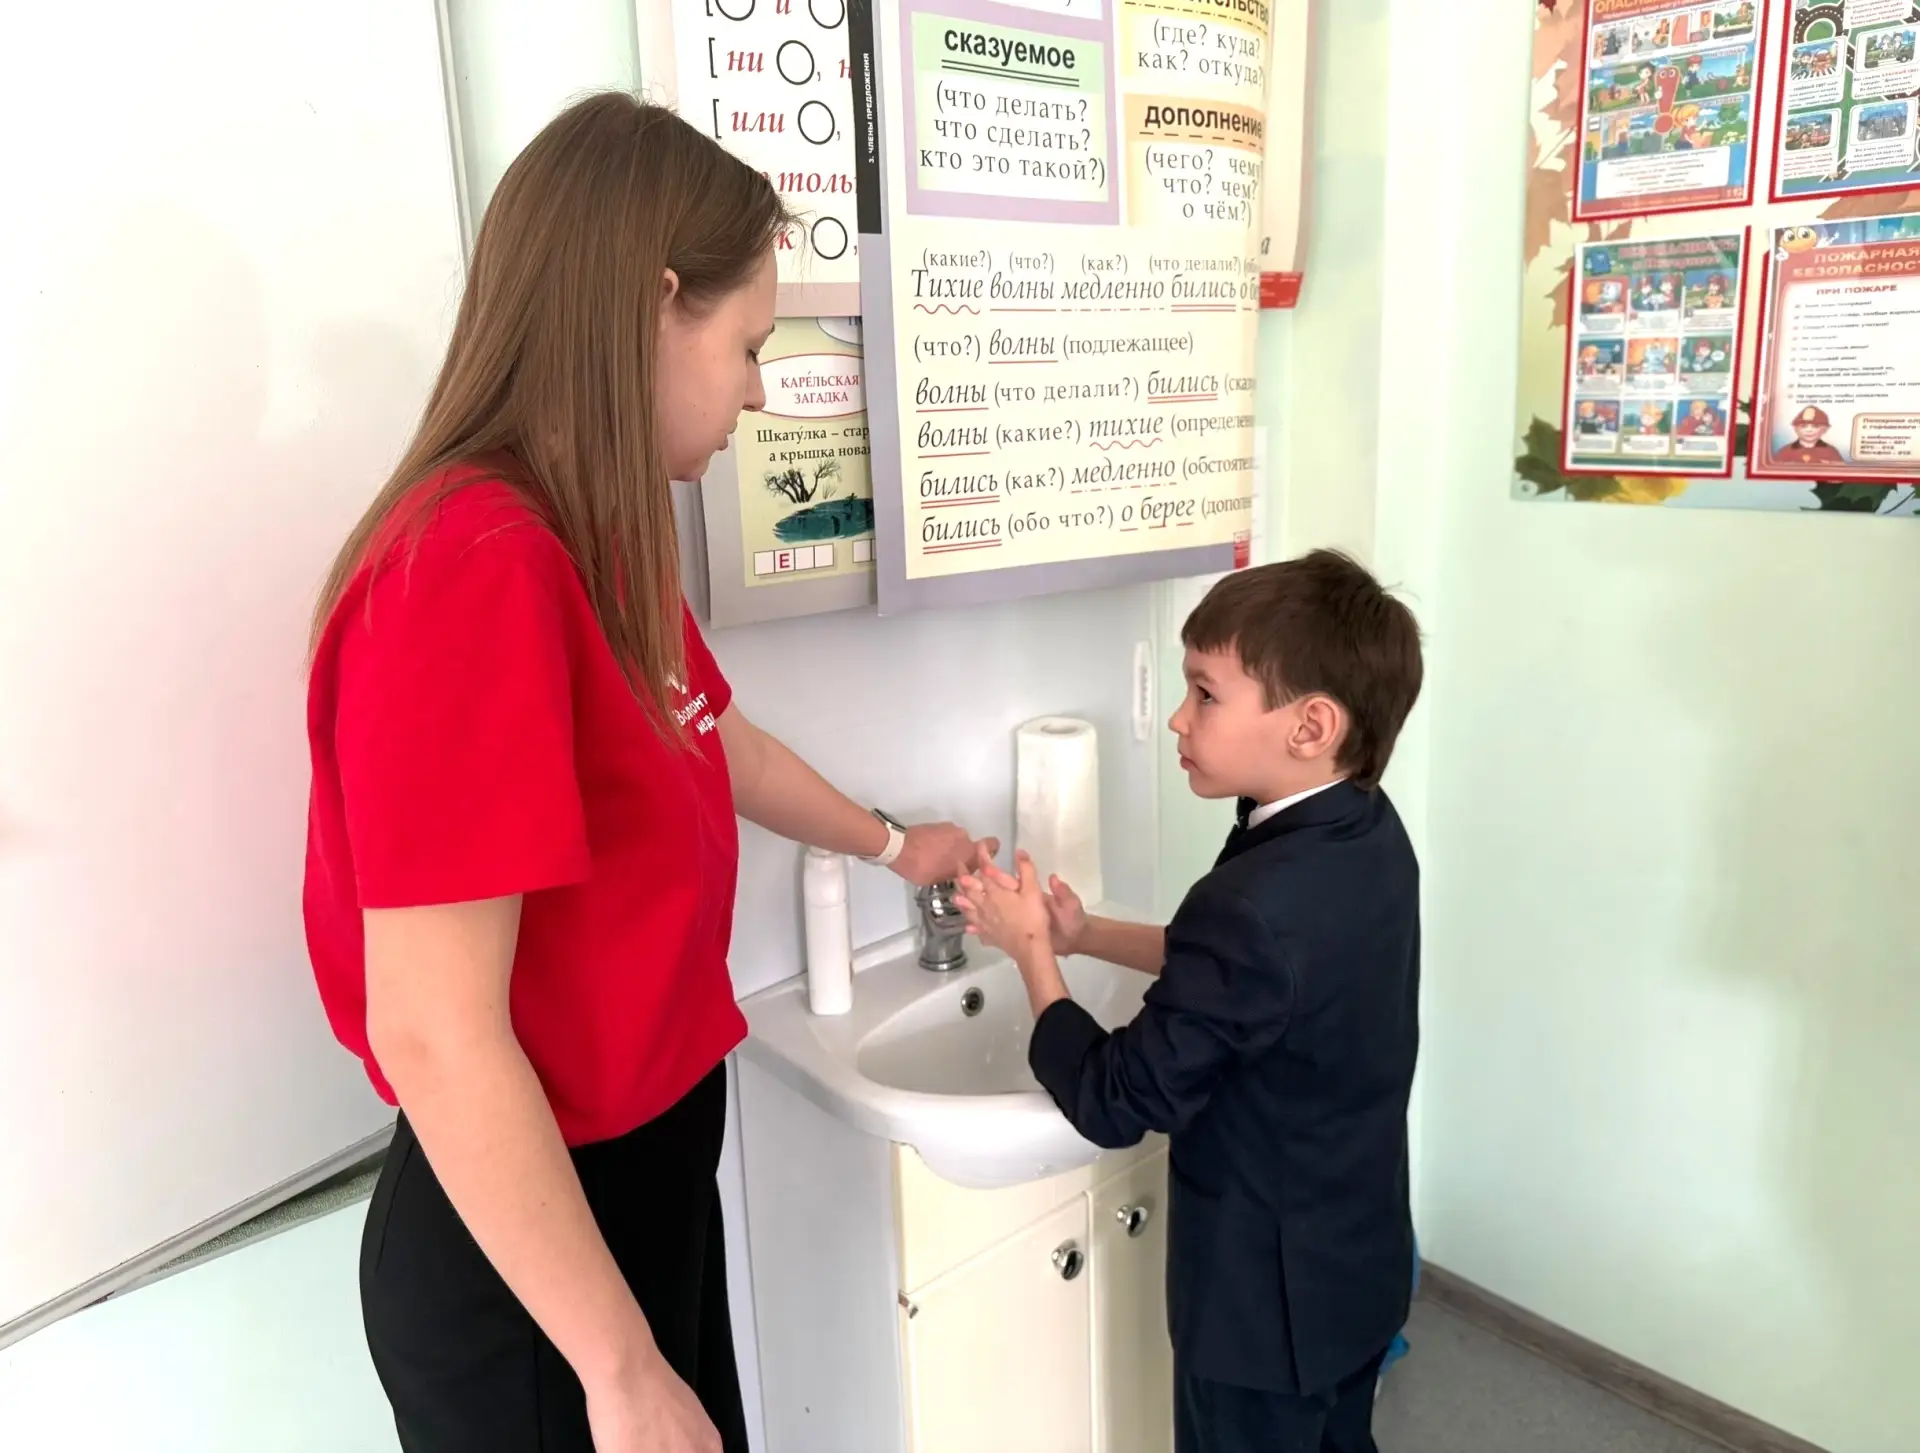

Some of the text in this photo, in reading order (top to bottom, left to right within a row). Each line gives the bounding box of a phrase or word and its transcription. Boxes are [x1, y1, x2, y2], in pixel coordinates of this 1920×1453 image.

[944, 29, 1076, 69] сказуемое
[1154, 18, 1261, 59] (где? куда?
[727, 50, 764, 73] ни
[1138, 49, 1188, 71] как?
[863, 53, 875, 164] 3. ЧЛЕНЫ ПРЕДЛОЖЕНИЯ
[936, 80, 1088, 122] (что делать?
[730, 111, 785, 133] или
[934, 119, 1091, 151] что сделать?
[1145, 106, 1263, 139] дополнение
[920, 149, 1106, 189] кто это такой?)
[1146, 145, 1214, 175] (чего?
[777, 171, 857, 194] толь
[1164, 173, 1258, 200] что? чем?
[1183, 200, 1251, 229] о чём?)
[923, 248, 992, 274] (какие?)
[1009, 251, 1054, 274] (что?)
[1081, 254, 1128, 275] (как?)
[1149, 255, 1180, 275] (что
[1184, 256, 1241, 275] делали?)
[1814, 247, 1920, 263] ПОЖАРНАЯ
[911, 269, 984, 298] Тихие
[990, 271, 1055, 300] волны
[1061, 273, 1165, 300] медленно
[1171, 273, 1237, 299] бились
[1844, 284, 1898, 294] ПОЖАРЕ
[914, 329, 1194, 363] (что?) волны (подлежащее)
[794, 391, 849, 405] ЗАГАДКА
[916, 377, 987, 405] волны
[995, 381, 1036, 408] (что
[1043, 376, 1139, 403] делали?)
[1147, 370, 1219, 395] бились
[918, 421, 988, 449] волны
[996, 420, 1081, 450] (какие?)
[1089, 416, 1164, 438] тихие
[769, 444, 871, 465] а крышка нова
[920, 470, 998, 498] бились
[1005, 467, 1065, 496] (как?)
[1071, 457, 1176, 485] медленно
[922, 516, 1001, 542] бились
[1008, 513, 1050, 540] (обо
[1058, 505, 1114, 530] что?)
[1121, 505, 1133, 522] о
[1141, 496, 1195, 527] берег
[779, 553, 790, 569] Е
